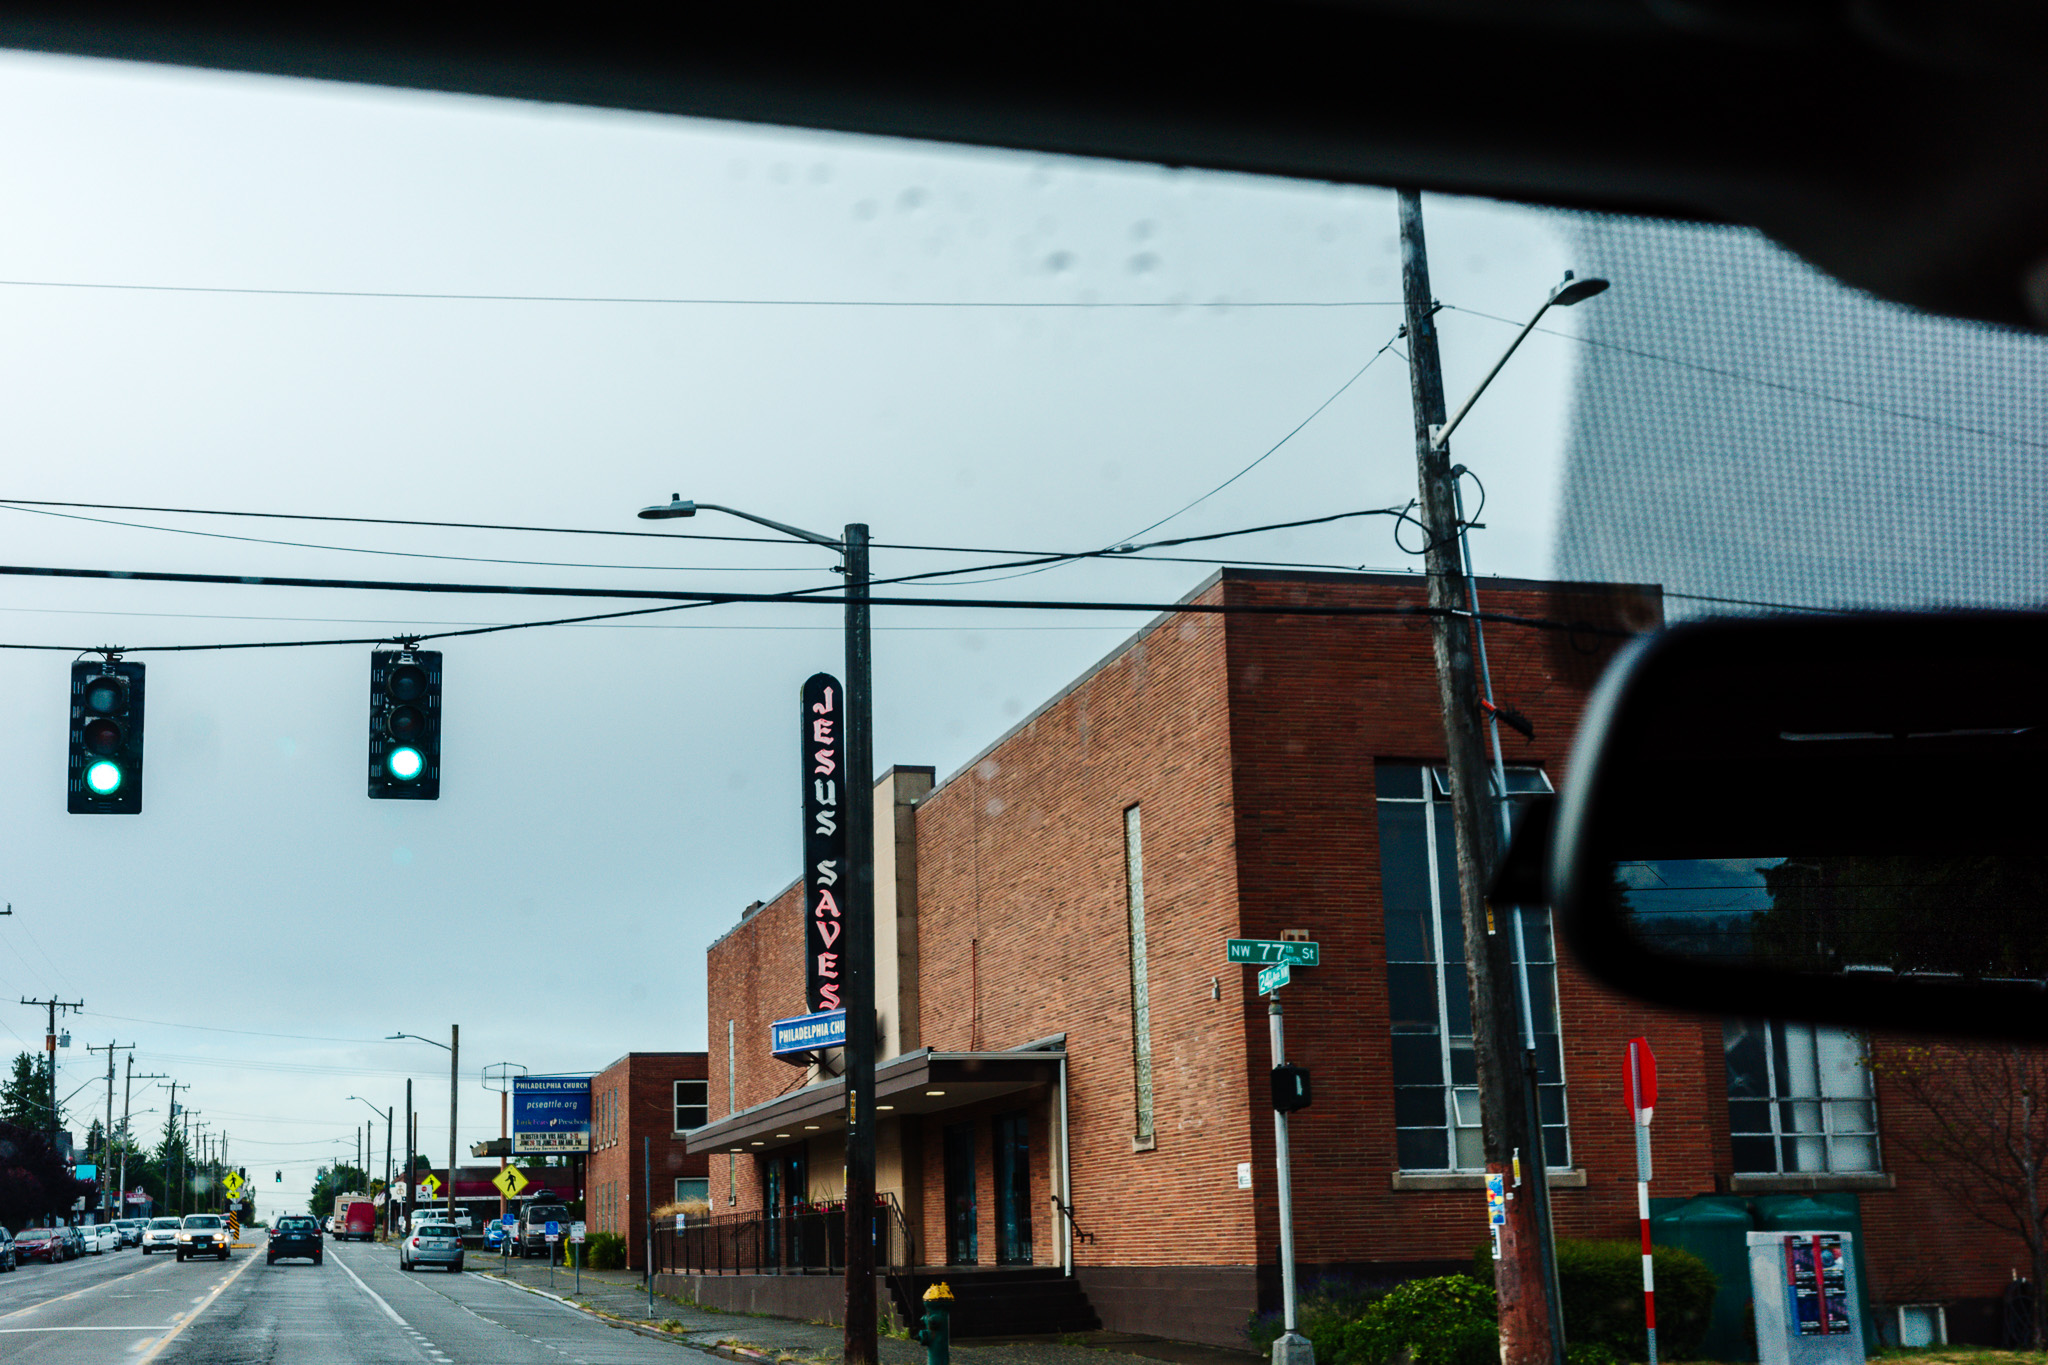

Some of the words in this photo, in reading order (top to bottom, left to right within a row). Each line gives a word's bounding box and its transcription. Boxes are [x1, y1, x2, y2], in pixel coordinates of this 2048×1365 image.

[812, 685, 837, 837] JESUS
[816, 858, 841, 1011] SAVES
[1231, 944, 1250, 957] NW
[1302, 947, 1314, 960] St
[778, 1022, 829, 1044] PHILADELPHIA
[526, 1100, 578, 1110] pcseattle.org
